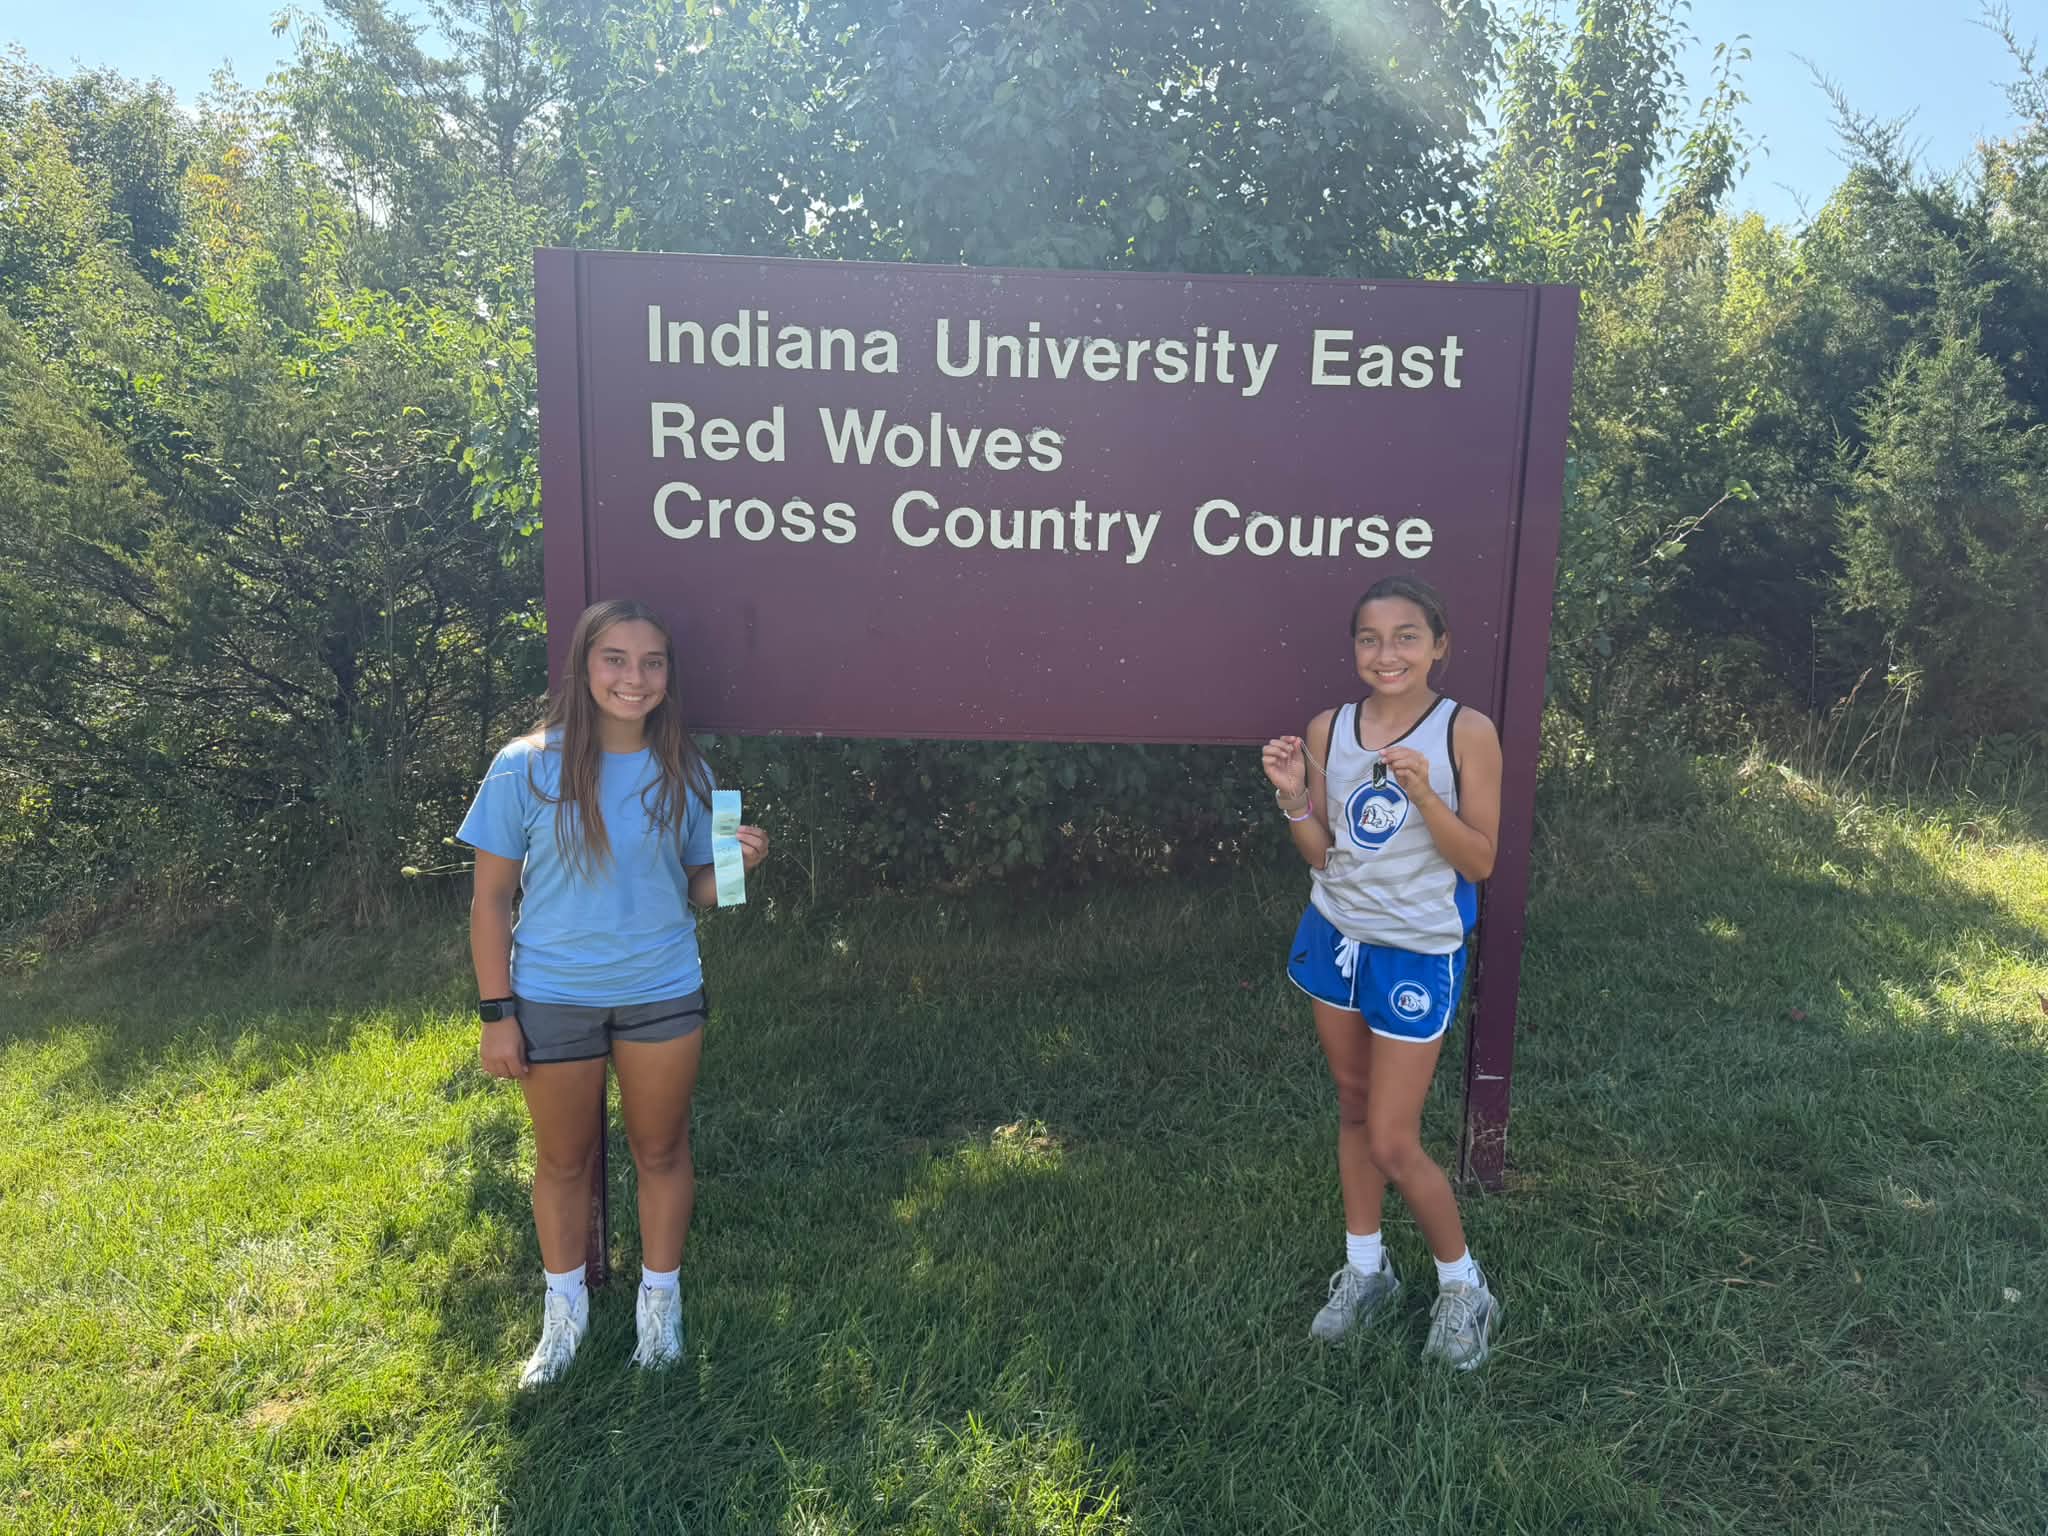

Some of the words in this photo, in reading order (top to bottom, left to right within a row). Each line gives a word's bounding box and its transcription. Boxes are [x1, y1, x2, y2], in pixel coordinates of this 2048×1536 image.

[647, 304, 900, 374] Indiana
[935, 317, 1279, 398] University
[1311, 329, 1465, 390] East
[650, 401, 787, 463] Red
[818, 407, 1067, 472] Wolves
[653, 481, 857, 544] Cross
[891, 489, 1163, 565] Country
[1192, 498, 1435, 559] Course
